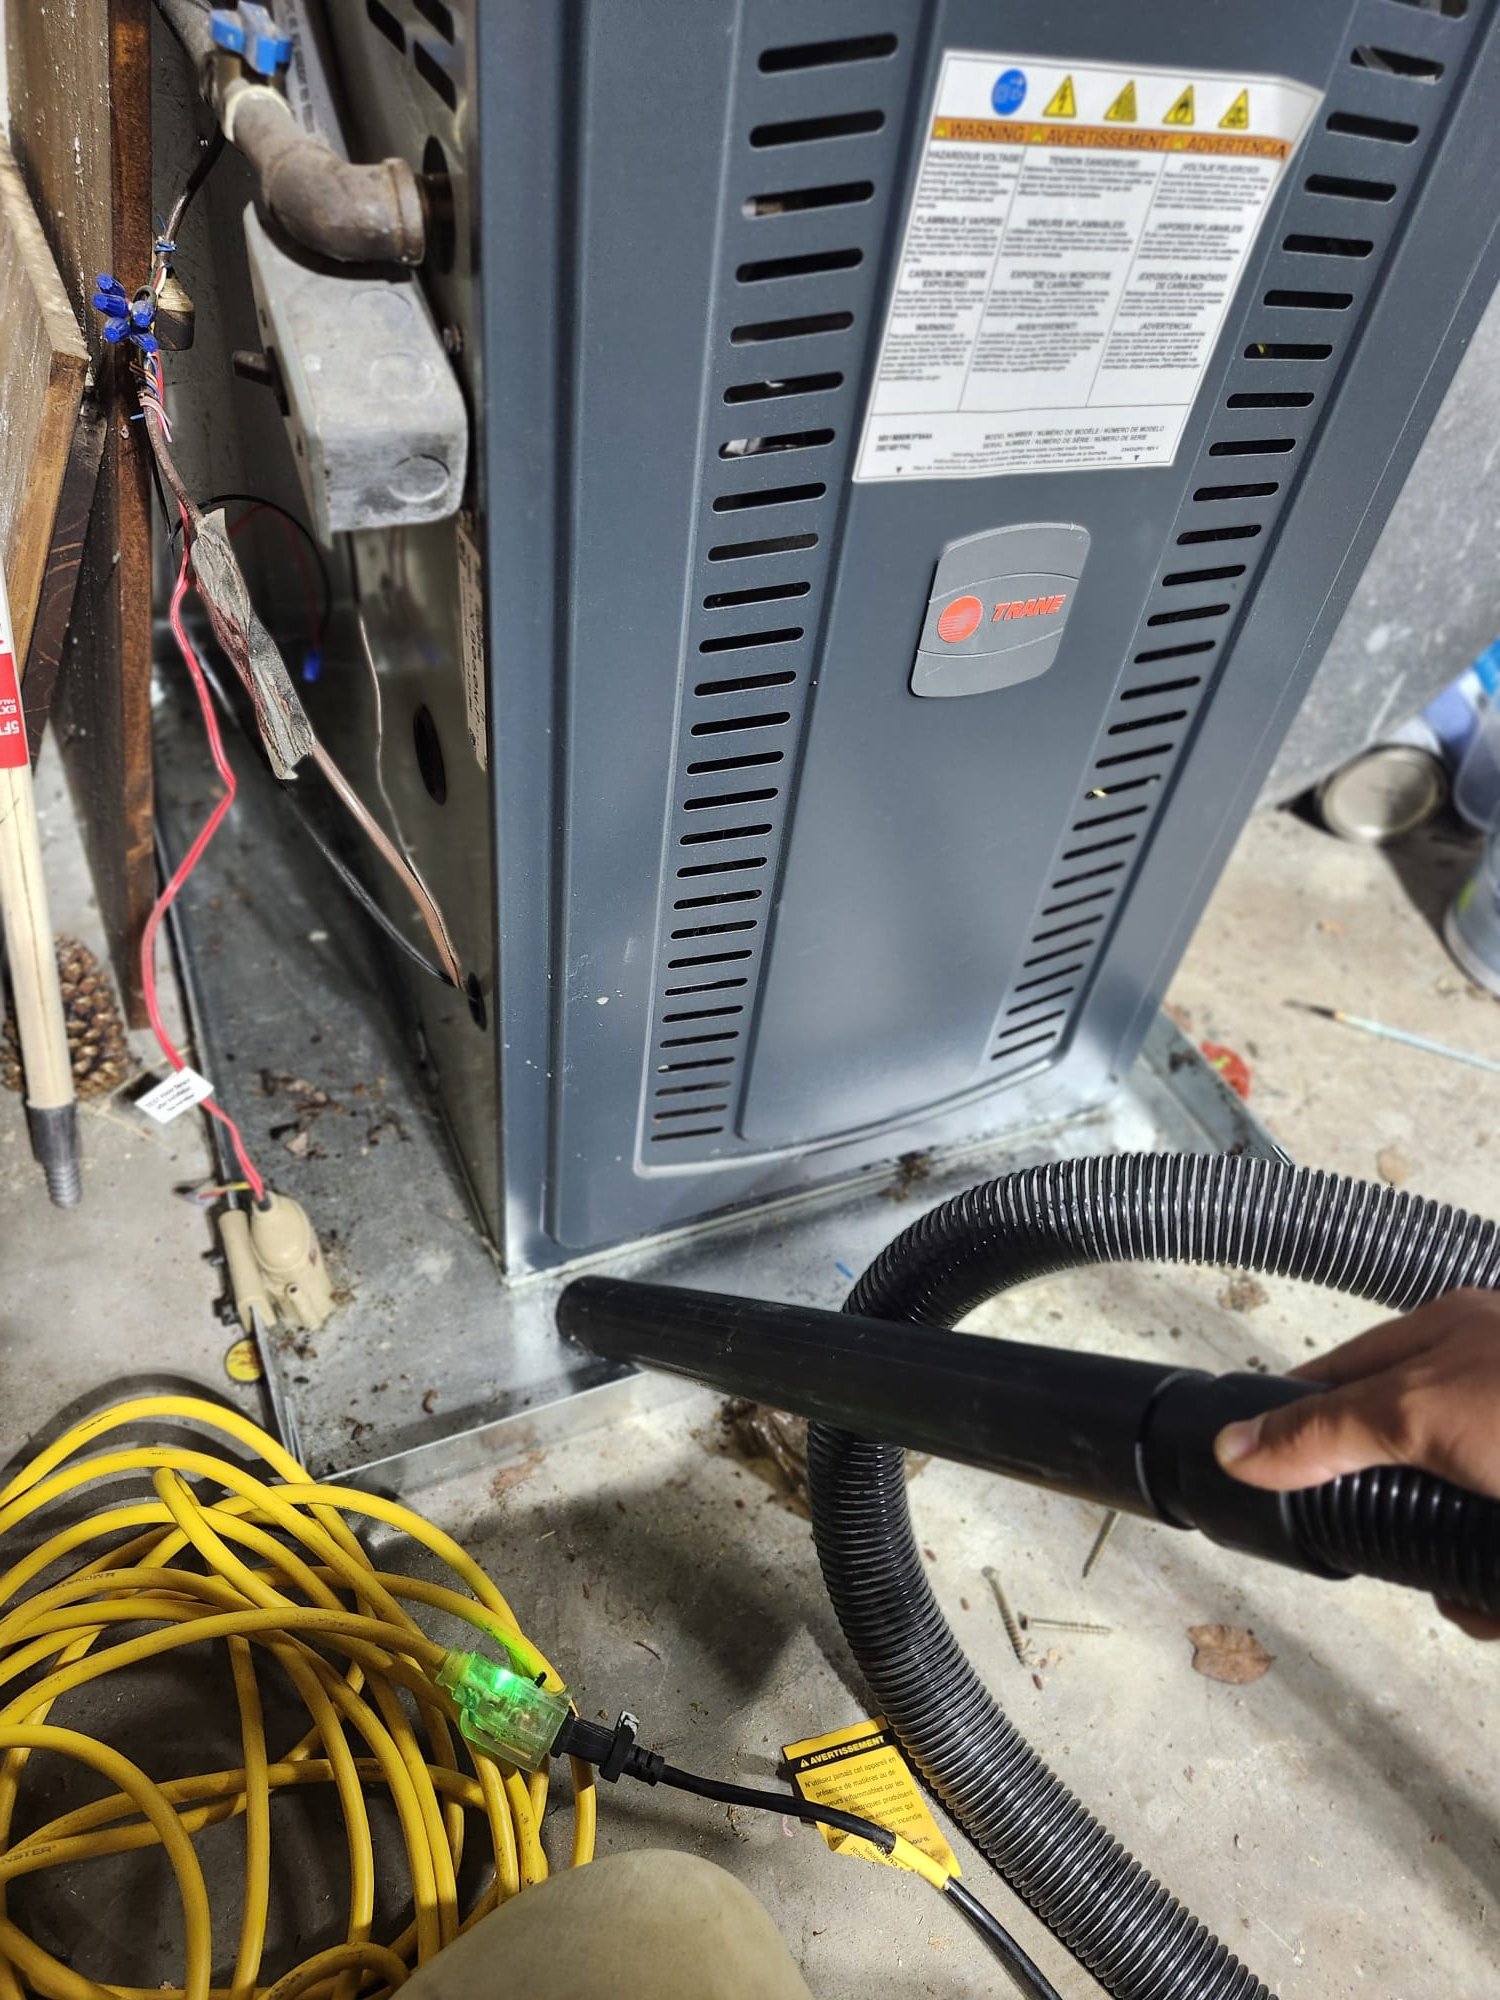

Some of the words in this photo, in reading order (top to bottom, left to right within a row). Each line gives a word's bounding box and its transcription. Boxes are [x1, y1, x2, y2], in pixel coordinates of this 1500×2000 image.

[951, 123, 1025, 143] WARNING
[1046, 128, 1168, 149] AVERTISSEMENT
[1187, 137, 1286, 159] ADVERTENCIA
[991, 594, 1067, 623] TRANE
[810, 1735, 885, 1765] AVERTISSEMENT
[804, 1775, 832, 1788] N'utilisez
[833, 1769, 853, 1782] jamais
[853, 1766, 865, 1774] cet
[864, 1759, 888, 1771] appareil
[888, 1756, 896, 1764] en
[815, 1785, 843, 1799] présence
[852, 1774, 879, 1786] matières
[887, 1769, 896, 1777] de
[884, 1782, 894, 1790] car
[904, 1802, 914, 1811] qui
